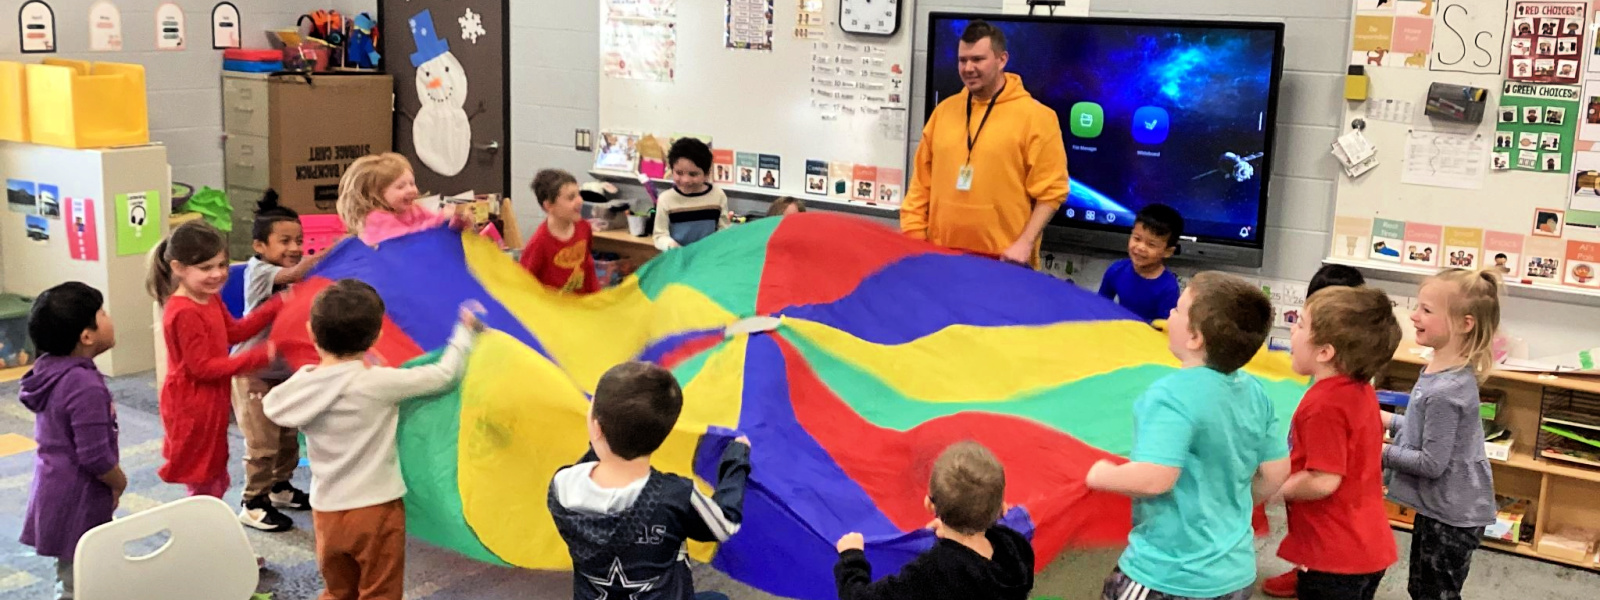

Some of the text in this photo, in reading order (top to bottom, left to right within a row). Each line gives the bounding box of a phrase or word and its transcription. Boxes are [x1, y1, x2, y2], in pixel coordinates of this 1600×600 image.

[1525, 6, 1576, 15] RED CHOICES
[1512, 85, 1572, 98] GREEN CHOICES
[308, 144, 370, 161] STORAGE CART
[296, 164, 339, 180] BACKPACK
